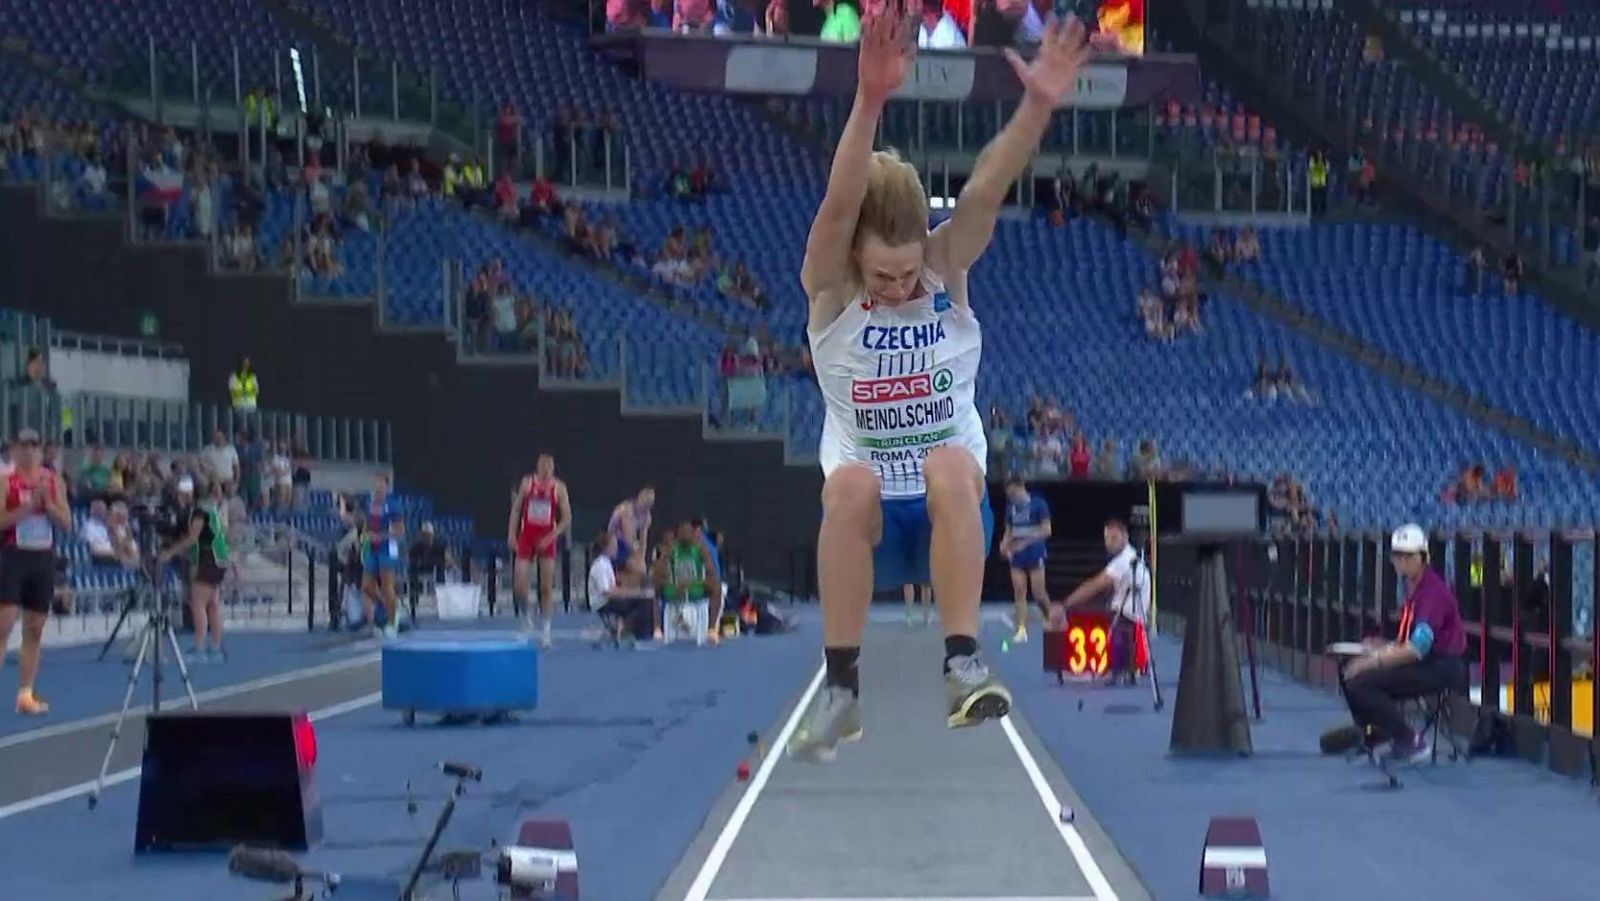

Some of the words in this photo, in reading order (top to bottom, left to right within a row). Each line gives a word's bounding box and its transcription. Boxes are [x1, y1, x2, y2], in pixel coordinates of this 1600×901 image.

[863, 320, 946, 350] CZECHIA
[854, 378, 930, 400] SPAR
[855, 396, 954, 430] MEINDLSCHMID
[881, 439, 903, 448] RUN
[904, 432, 938, 445] CLEAN
[870, 449, 915, 461] ROMA
[1069, 626, 1107, 673] 33
